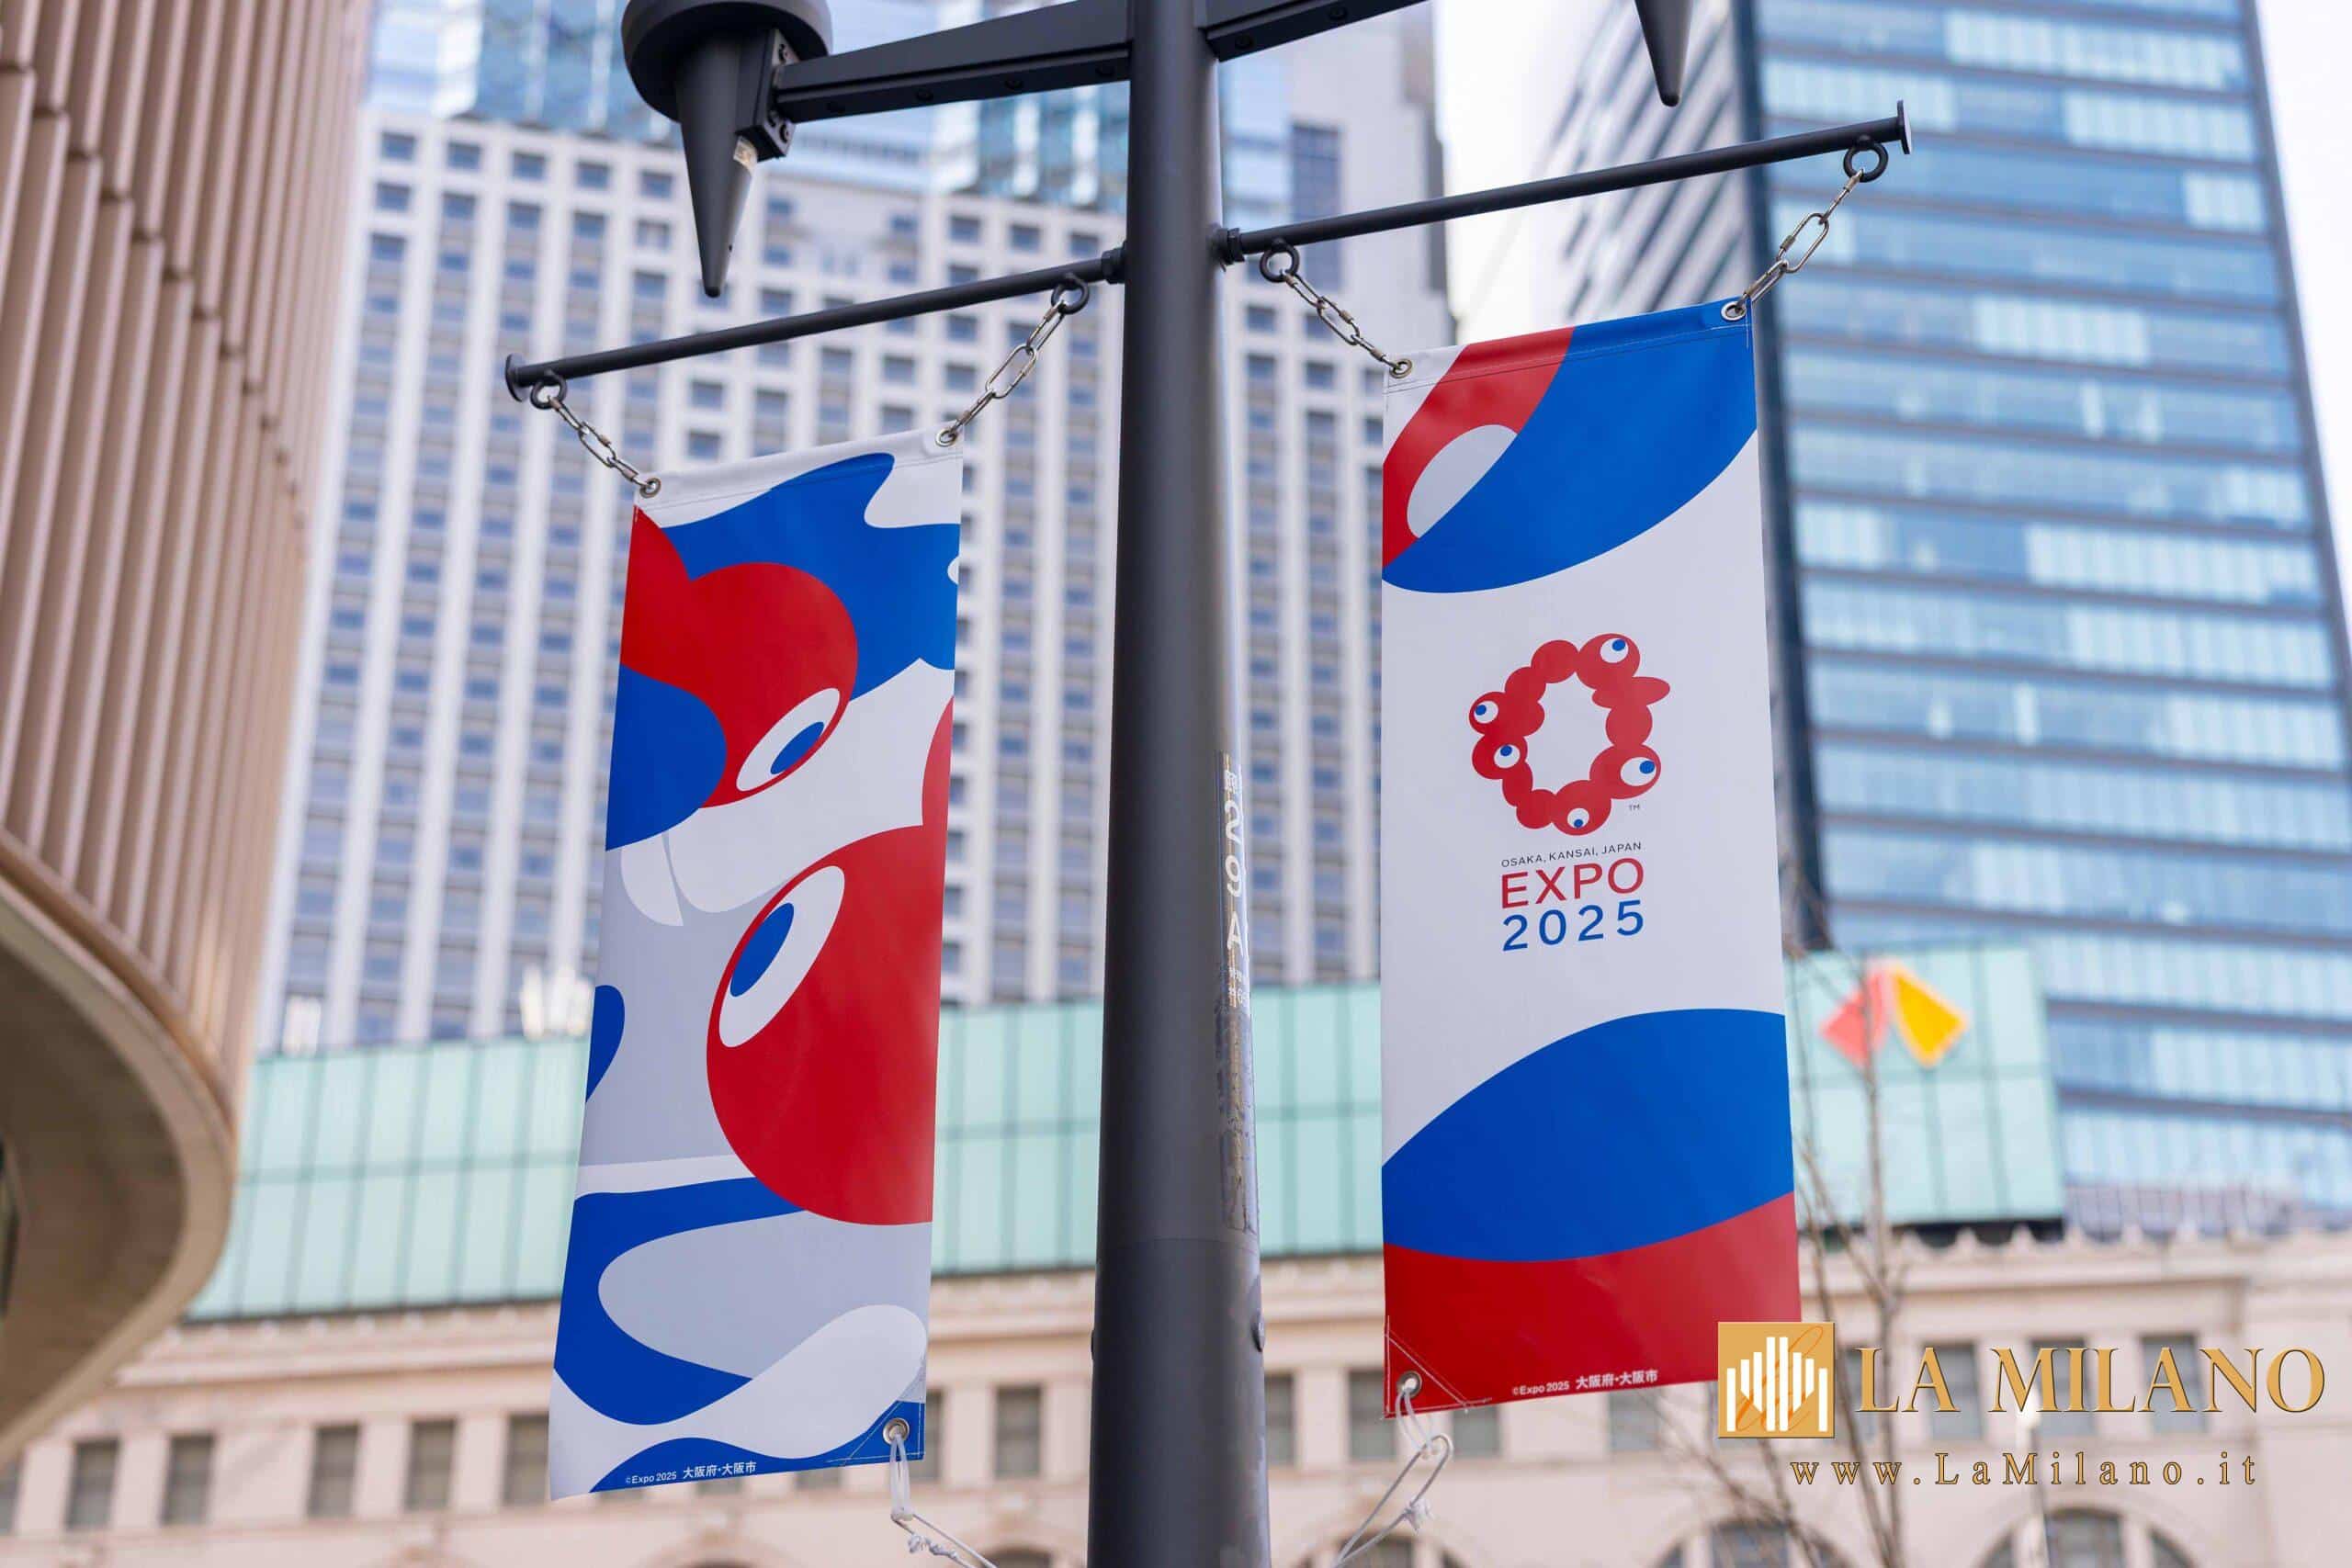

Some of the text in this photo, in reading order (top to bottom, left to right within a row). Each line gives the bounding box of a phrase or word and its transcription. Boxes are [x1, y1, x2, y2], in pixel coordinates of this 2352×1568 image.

[1500, 840, 1642, 868] OSAKA, KANSAI, JAPAN
[1500, 857, 1645, 909] EXPO
[1502, 898, 1645, 952] 2025
[1546, 1381, 1570, 1394] 2025
[655, 1471, 677, 1483] 2025
